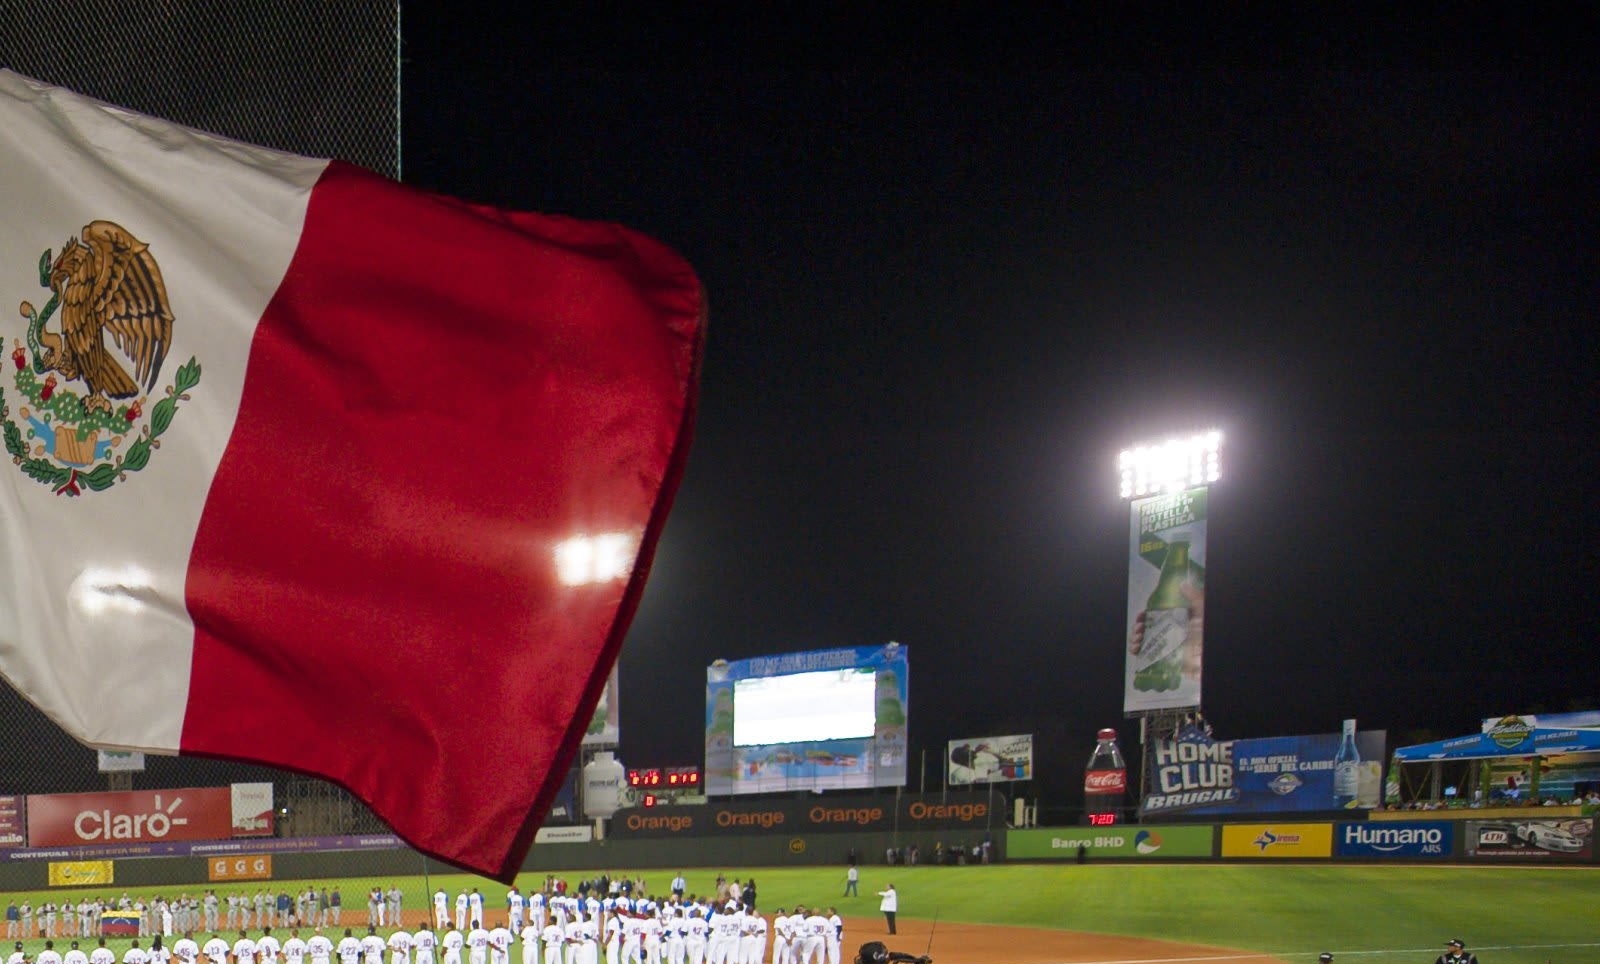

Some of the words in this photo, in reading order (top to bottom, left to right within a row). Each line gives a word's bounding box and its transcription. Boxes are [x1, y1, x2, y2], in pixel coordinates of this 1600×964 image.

[1156, 741, 1234, 765] HOME
[1300, 760, 1334, 771] CARIBE
[1159, 763, 1233, 793] CLUB
[1146, 788, 1235, 811] BRUGAL
[716, 810, 785, 828] Orange
[809, 806, 883, 824] Orange
[909, 802, 987, 821] Orange
[74, 809, 171, 840] Claro
[626, 815, 692, 832] Orange
[1052, 838, 1091, 849] Banco
[1095, 836, 1125, 848] BHD
[1345, 825, 1442, 845] Humano
[1421, 844, 1442, 853] ARS
[215, 861, 226, 874] G
[235, 860, 246, 873] G
[253, 859, 264, 871] G
